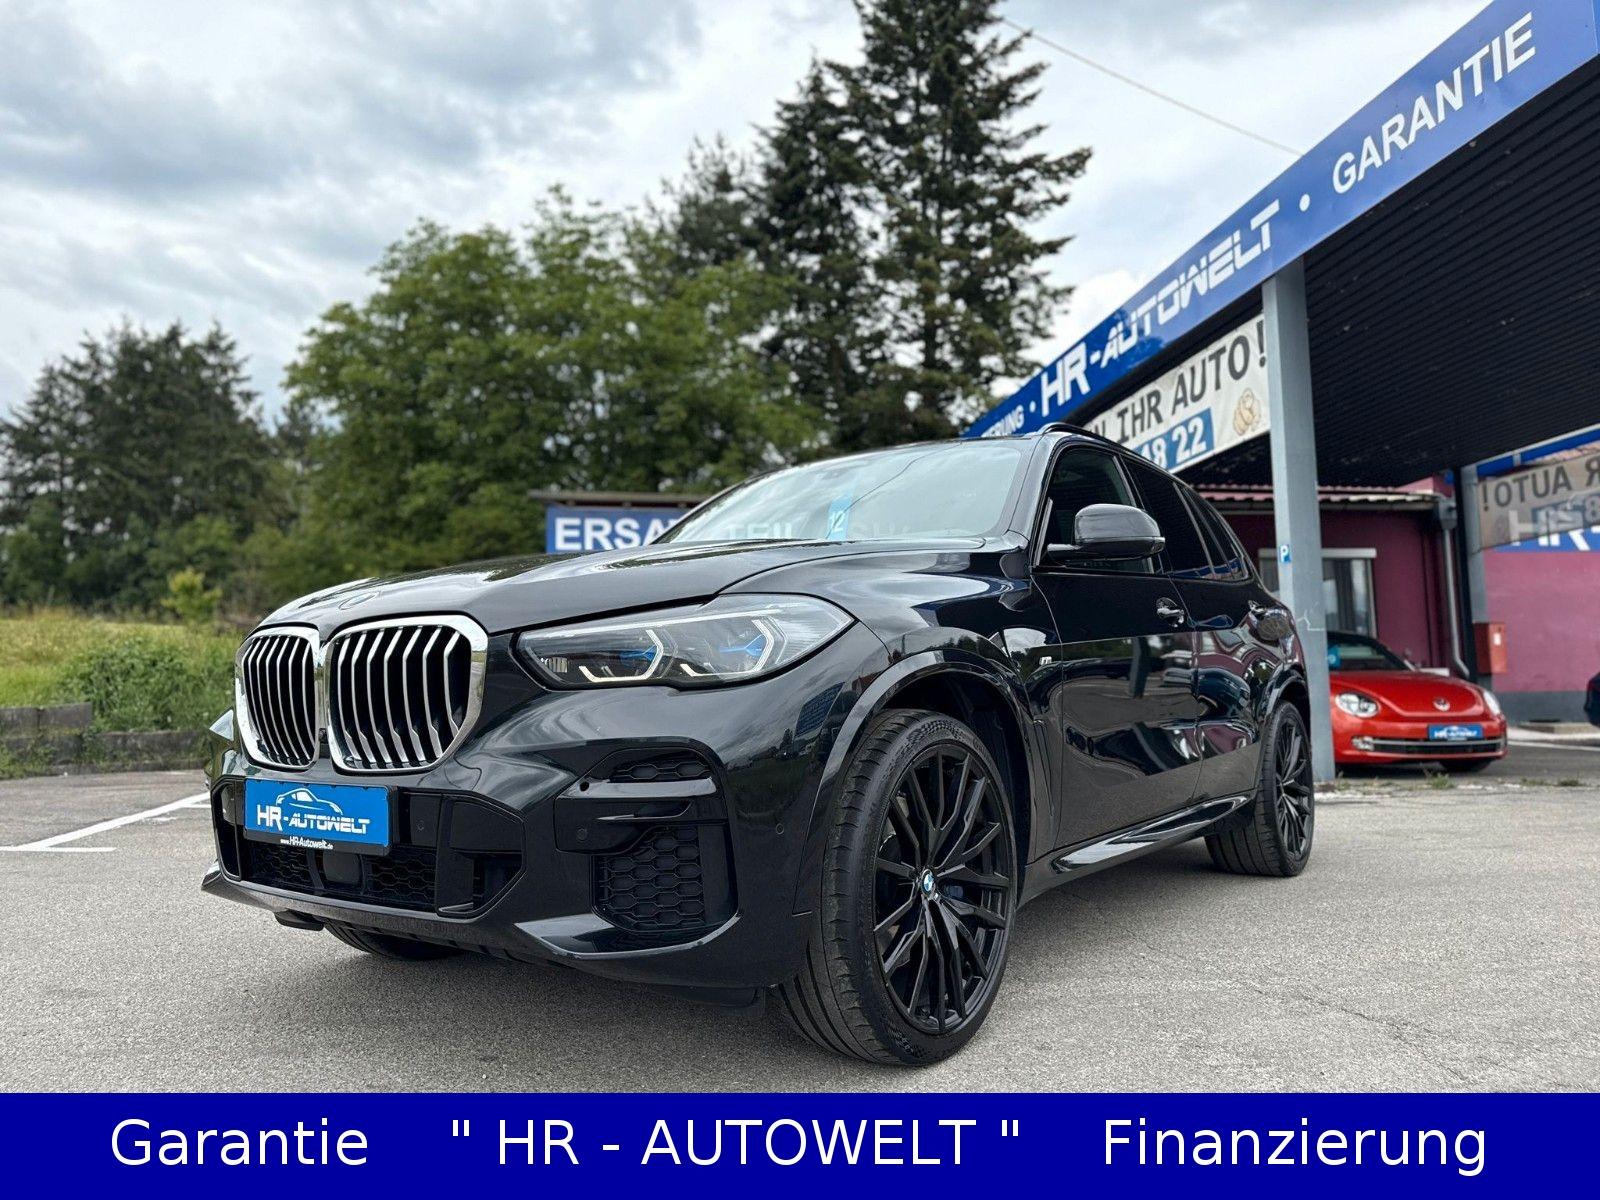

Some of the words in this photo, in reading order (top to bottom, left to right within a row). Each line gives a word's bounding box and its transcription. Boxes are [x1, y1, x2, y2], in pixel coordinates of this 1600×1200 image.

[1332, 11, 1536, 194] GARANTIE
[1117, 389, 1163, 443] IHR
[1172, 416, 1207, 465] 22
